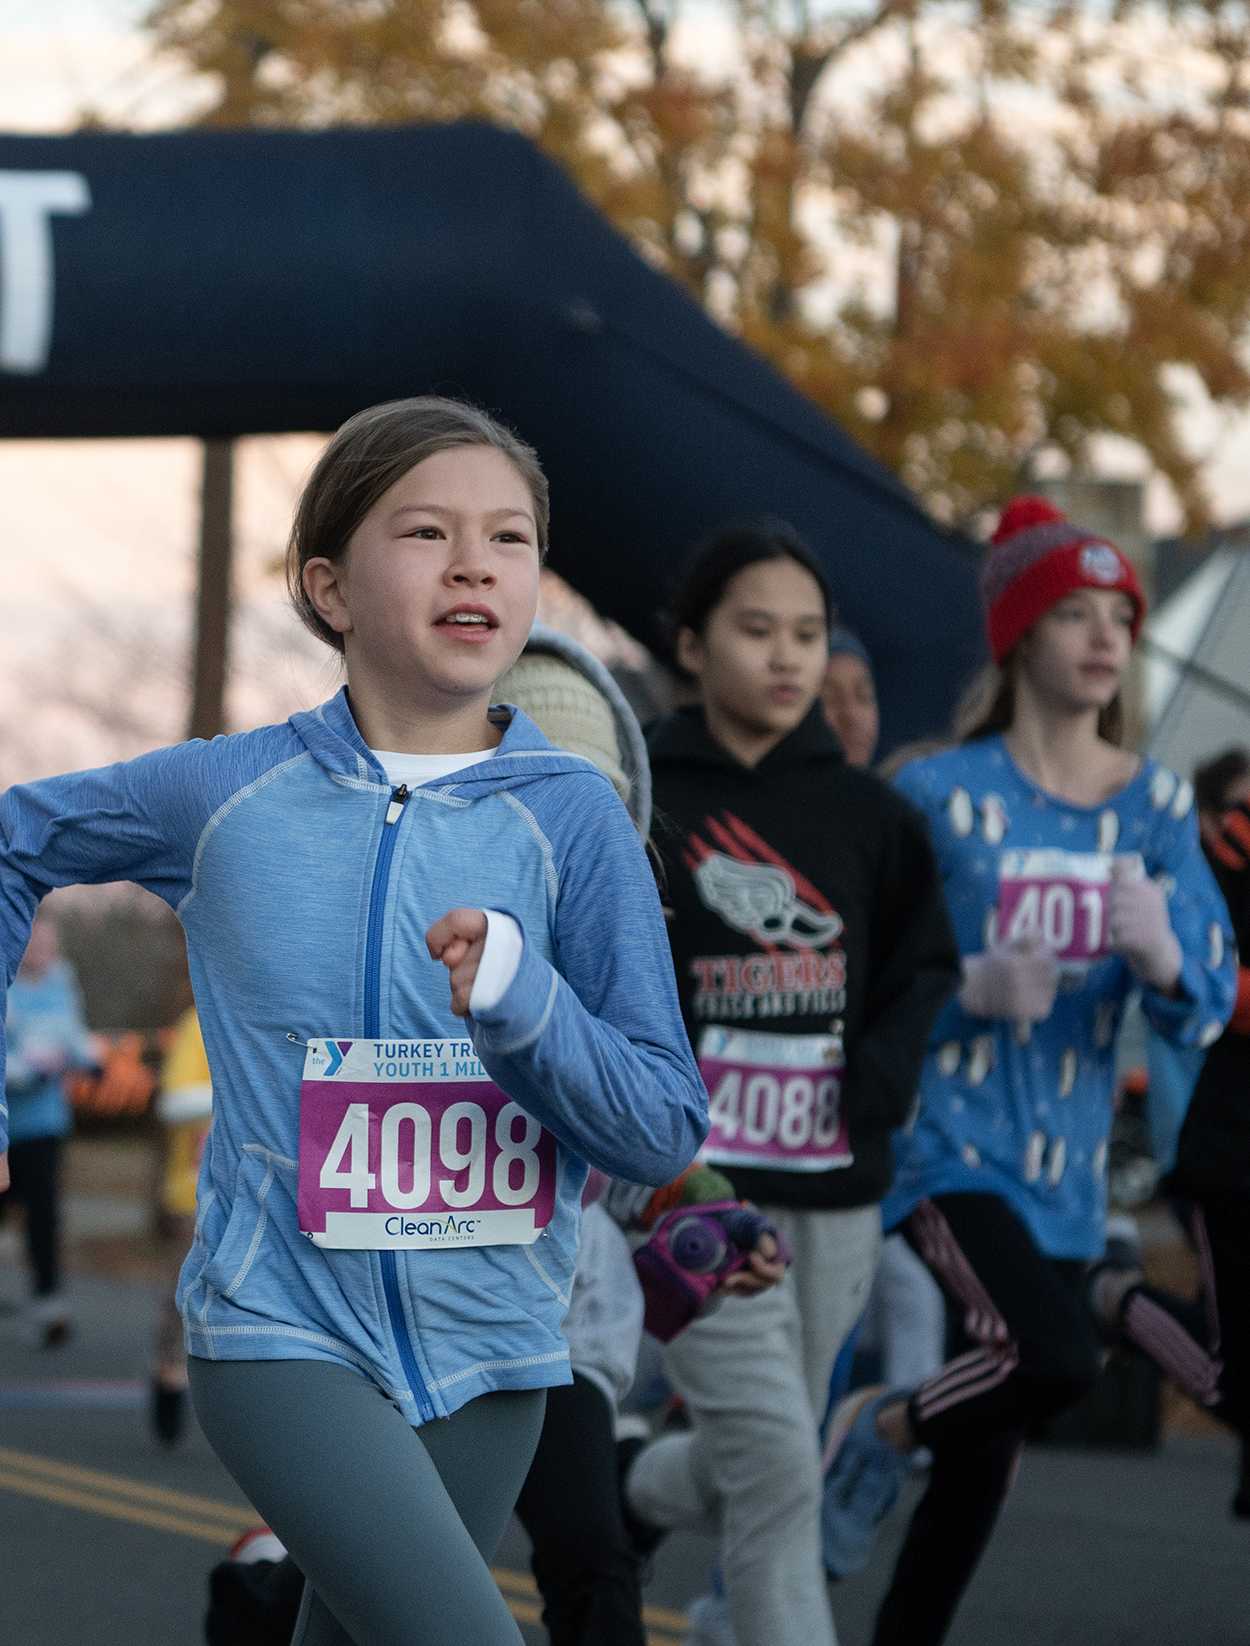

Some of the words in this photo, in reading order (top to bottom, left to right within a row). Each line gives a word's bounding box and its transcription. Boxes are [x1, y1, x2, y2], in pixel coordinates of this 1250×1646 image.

[1009, 884, 1113, 953] 401
[690, 950, 848, 995] TIGERS
[312, 1057, 326, 1065] the
[374, 1043, 444, 1058] TURKEY
[449, 1043, 479, 1058] TR
[374, 1062, 434, 1077] YOUTH
[440, 1062, 449, 1077] 1
[455, 1061, 486, 1077] MIL
[708, 1069, 842, 1148] 4088
[319, 1101, 542, 1210] 4098
